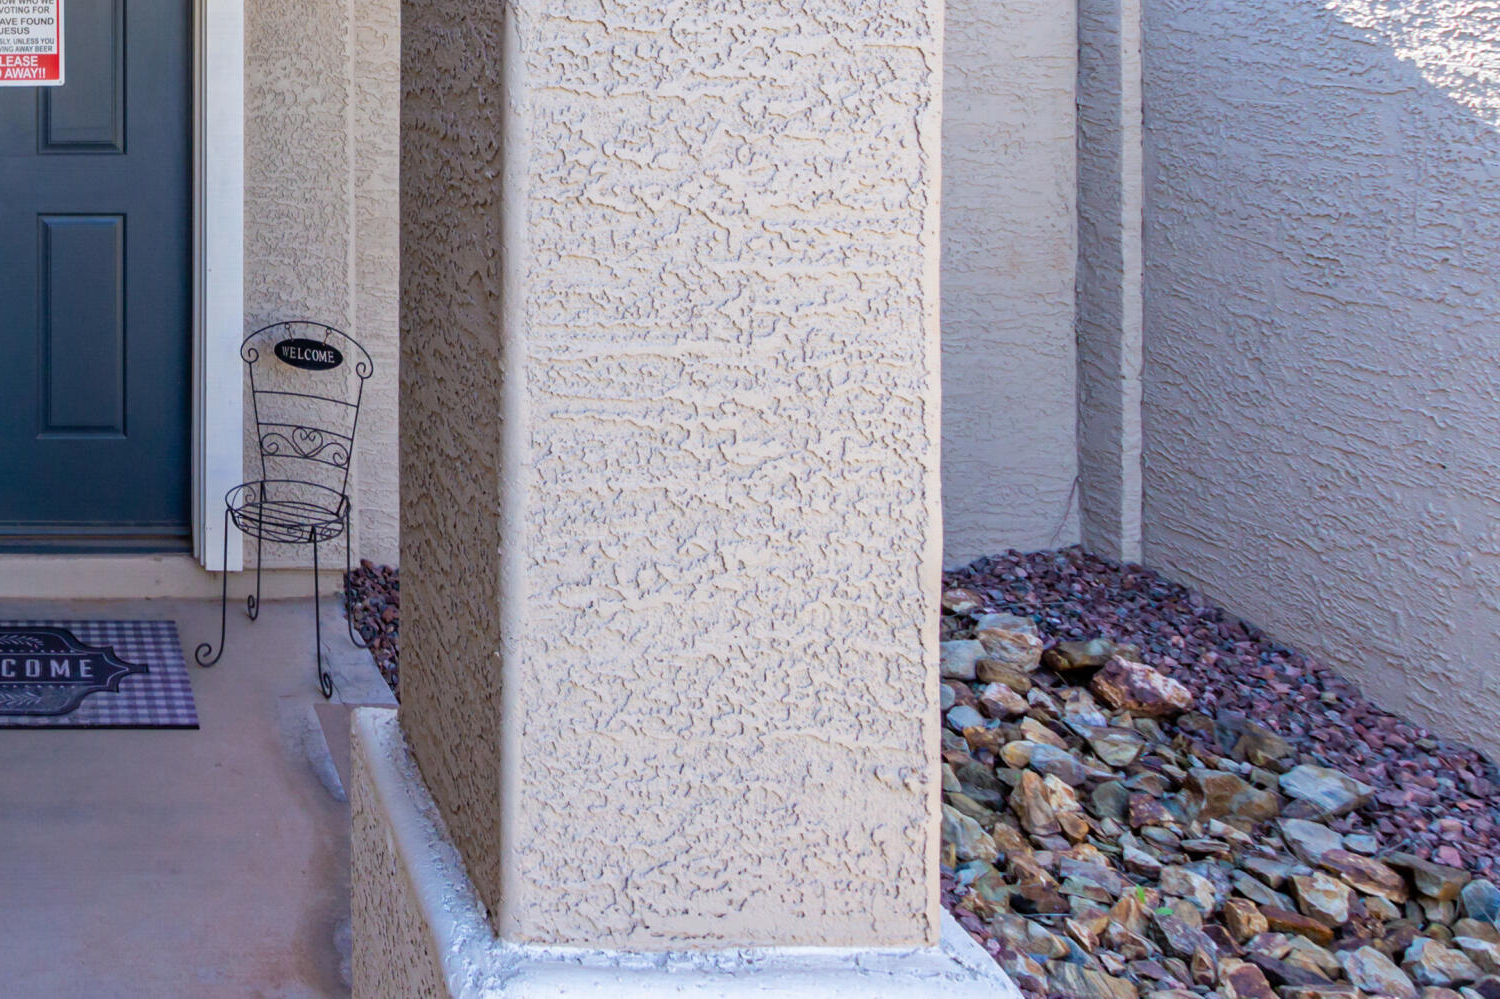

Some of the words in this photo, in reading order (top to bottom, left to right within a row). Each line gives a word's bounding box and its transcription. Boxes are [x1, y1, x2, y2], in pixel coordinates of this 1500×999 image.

[0, 6, 30, 14] VOTING
[32, 6, 50, 14] FOR
[20, 17, 54, 25] FOUND
[0, 26, 30, 35] JESUS
[4, 68, 46, 79] AWAY!!
[282, 346, 335, 363] WELCOME
